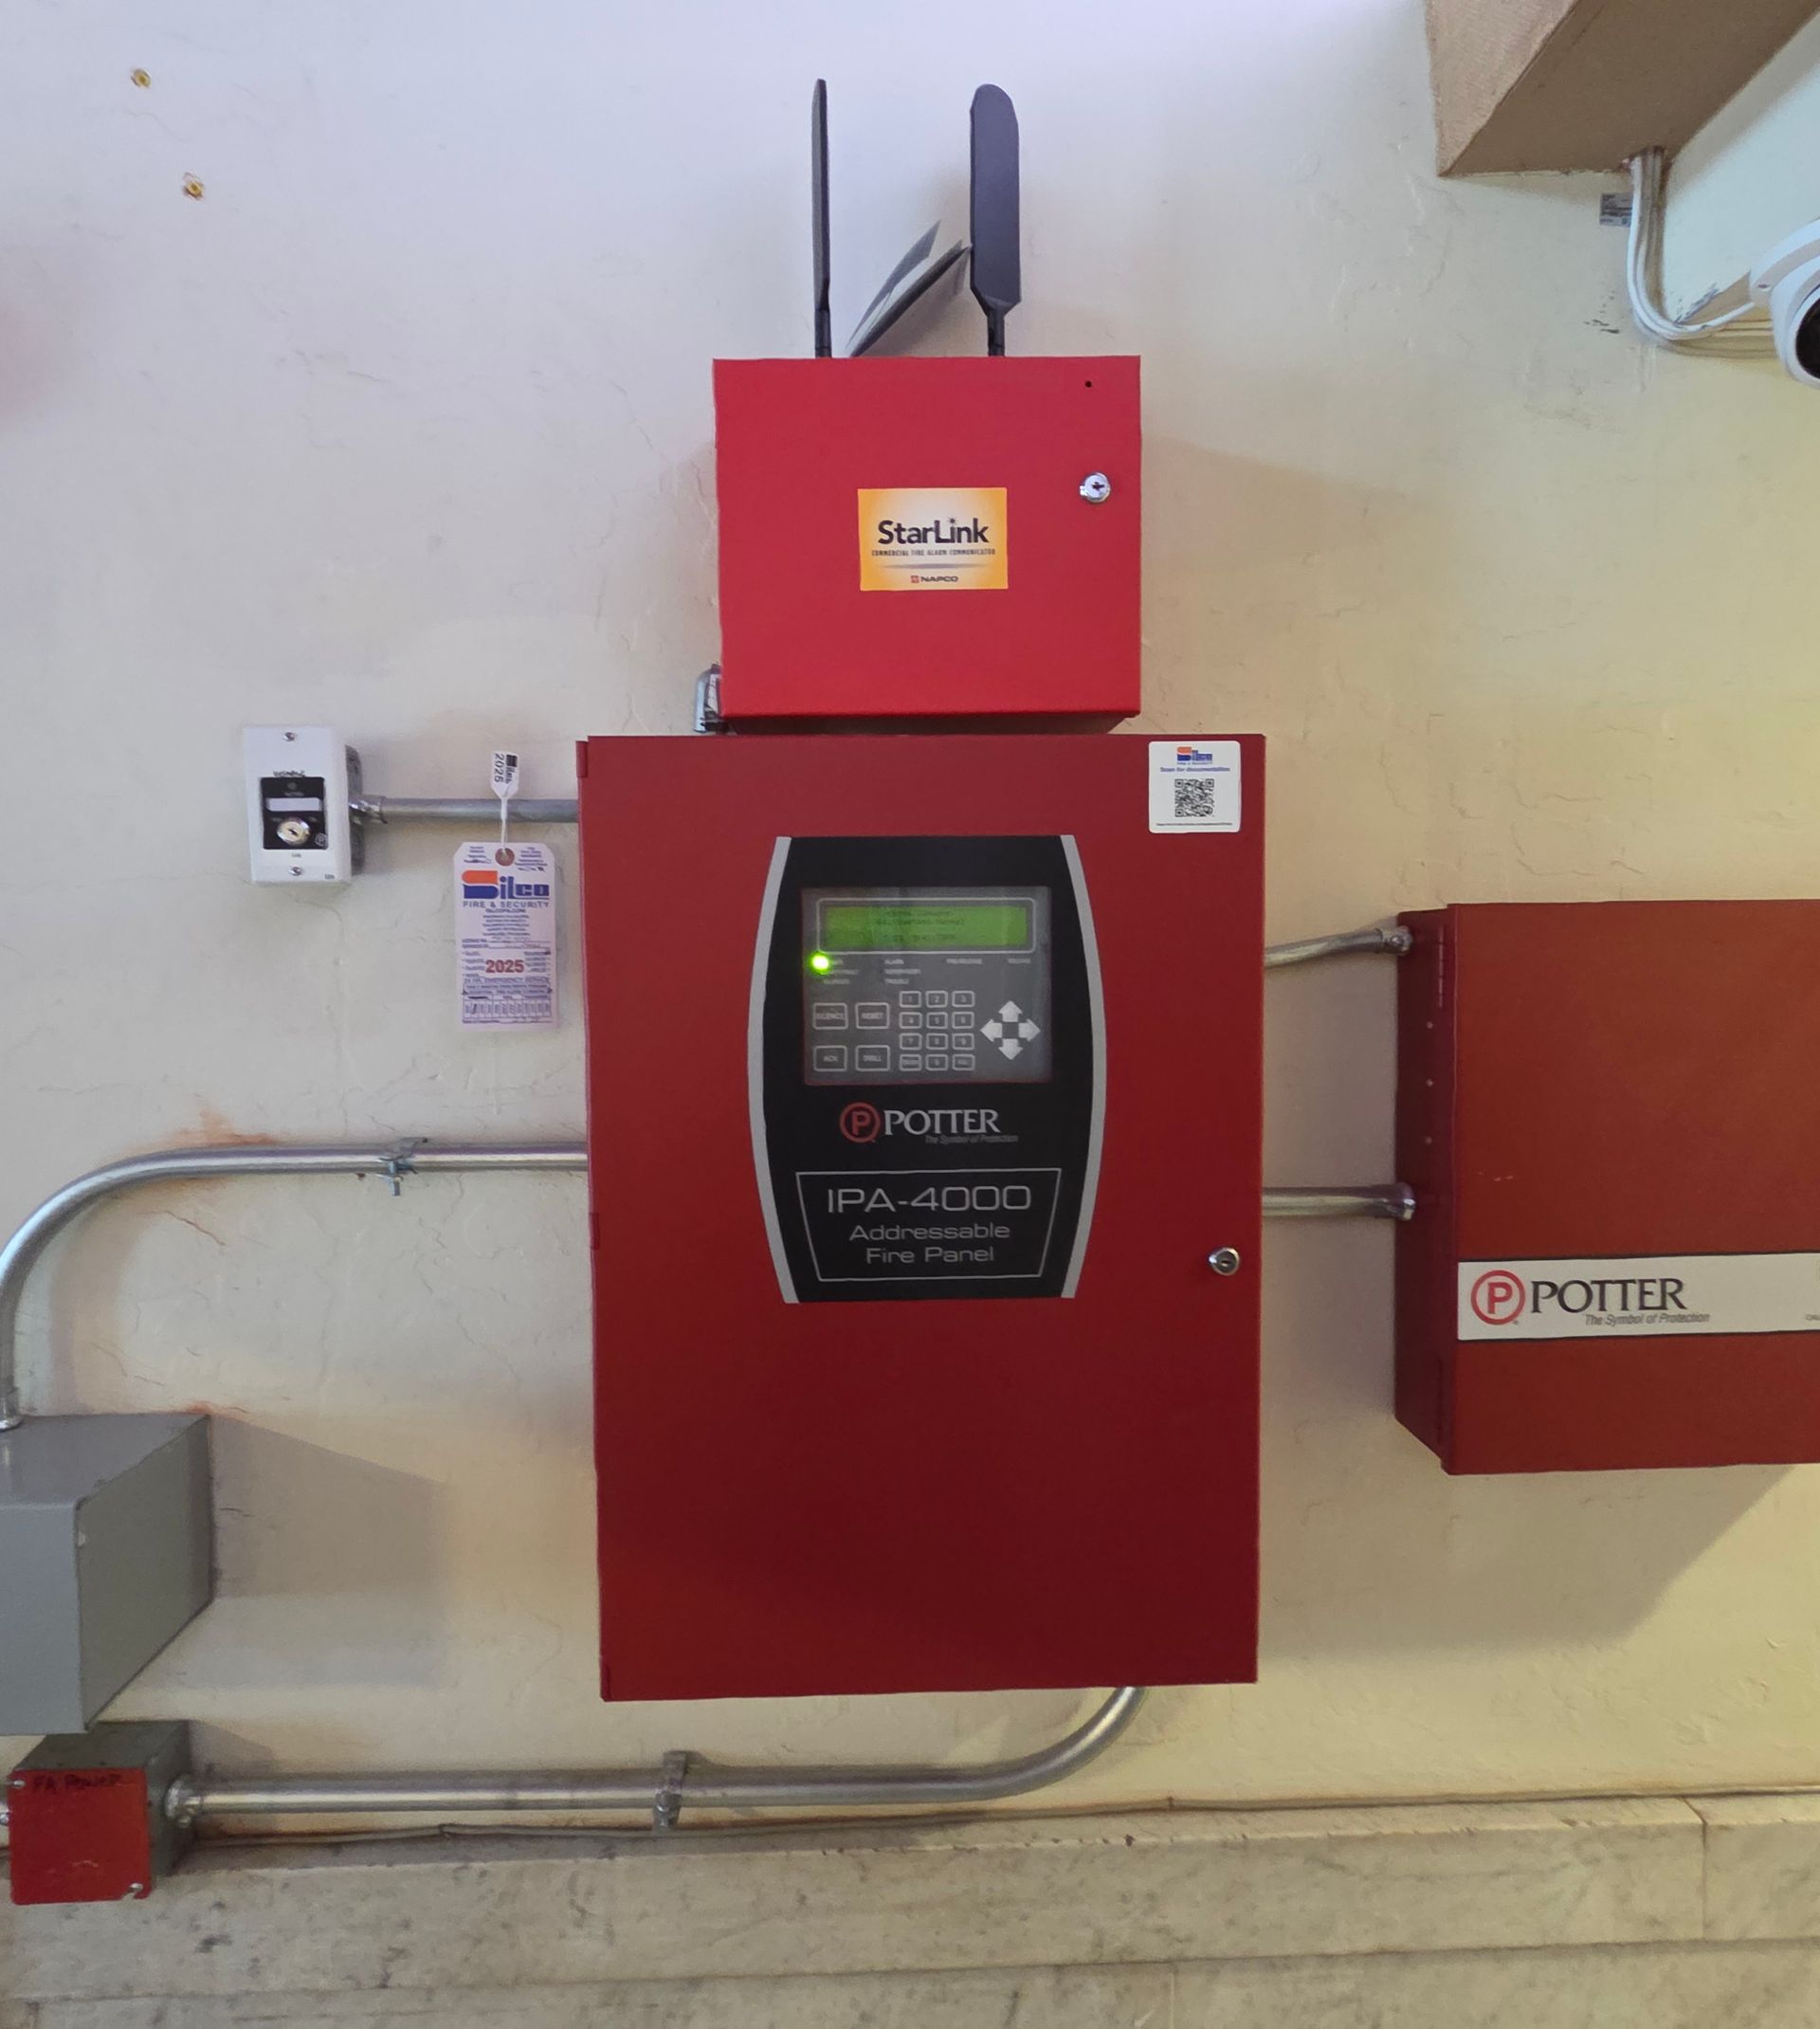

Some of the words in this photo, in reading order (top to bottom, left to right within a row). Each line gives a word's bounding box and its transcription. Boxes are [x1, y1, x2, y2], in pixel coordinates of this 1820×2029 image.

[878, 517, 989, 544] StarLink
[484, 960, 524, 974] 2025
[883, 1109, 1001, 1136] POTTER
[828, 1185, 1031, 1214] IPA-4000
[849, 1222, 1010, 1241] Addressable
[866, 1247, 915, 1264] Fire
[924, 1246, 993, 1263] Panel
[1531, 1277, 1688, 1314] POTTER
[1585, 1313, 1604, 1326] The
[1606, 1313, 1645, 1327] Symbol
[1647, 1313, 1658, 1324] of
[1658, 1312, 1710, 1324] Protection
